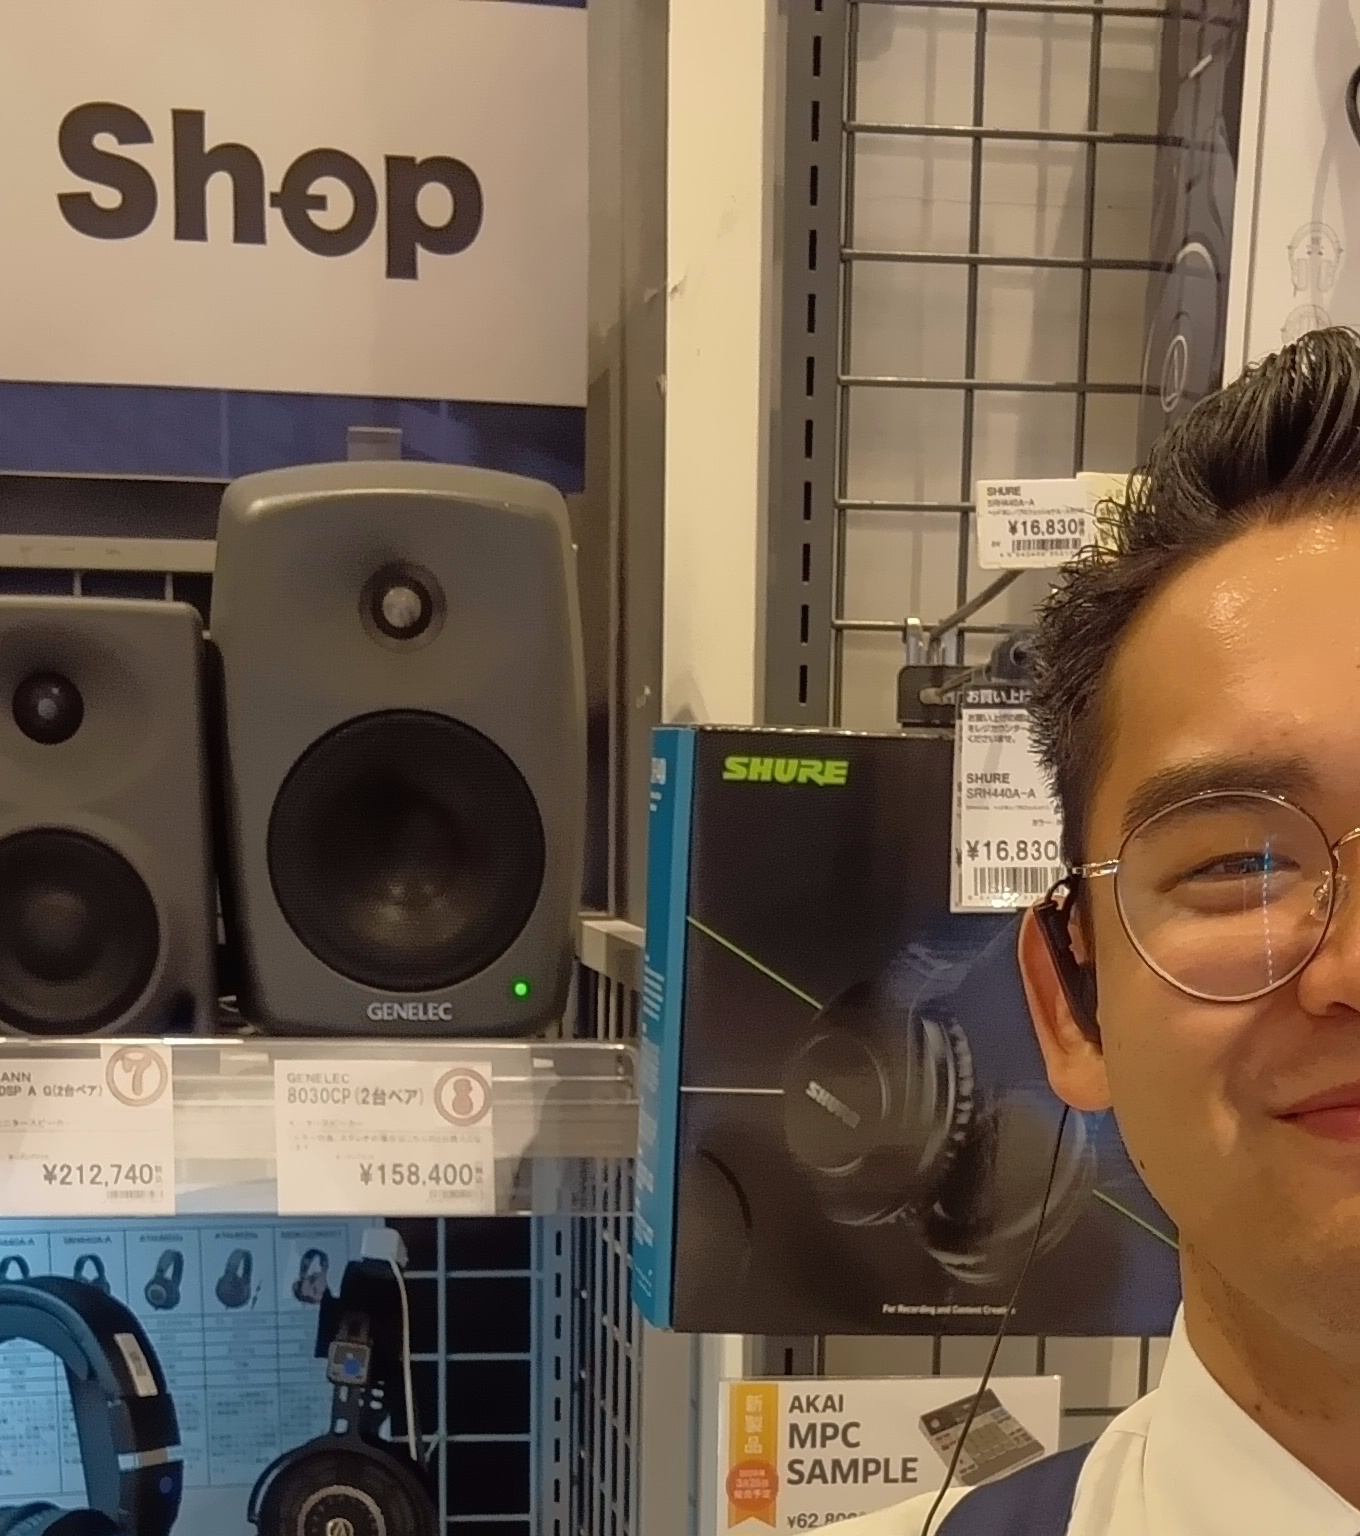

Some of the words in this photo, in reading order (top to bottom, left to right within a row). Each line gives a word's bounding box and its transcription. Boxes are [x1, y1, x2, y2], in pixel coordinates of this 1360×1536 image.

[56, 101, 485, 281] Shop
[986, 486, 1022, 497] SHURE
[1007, 519, 1078, 537] ¥16,830
[721, 755, 850, 787] SHURE
[966, 772, 1011, 784] SHURE
[965, 839, 1059, 863] ¥16,830
[366, 1002, 453, 1021] GENELEC
[287, 1072, 350, 1084] GENELEC
[42, 1163, 154, 1187] ¥212,740
[359, 1162, 473, 1186] ¥158,400
[788, 1393, 844, 1414] AKAI
[788, 1420, 862, 1450] MPC
[786, 1456, 919, 1486] SAMPLE
